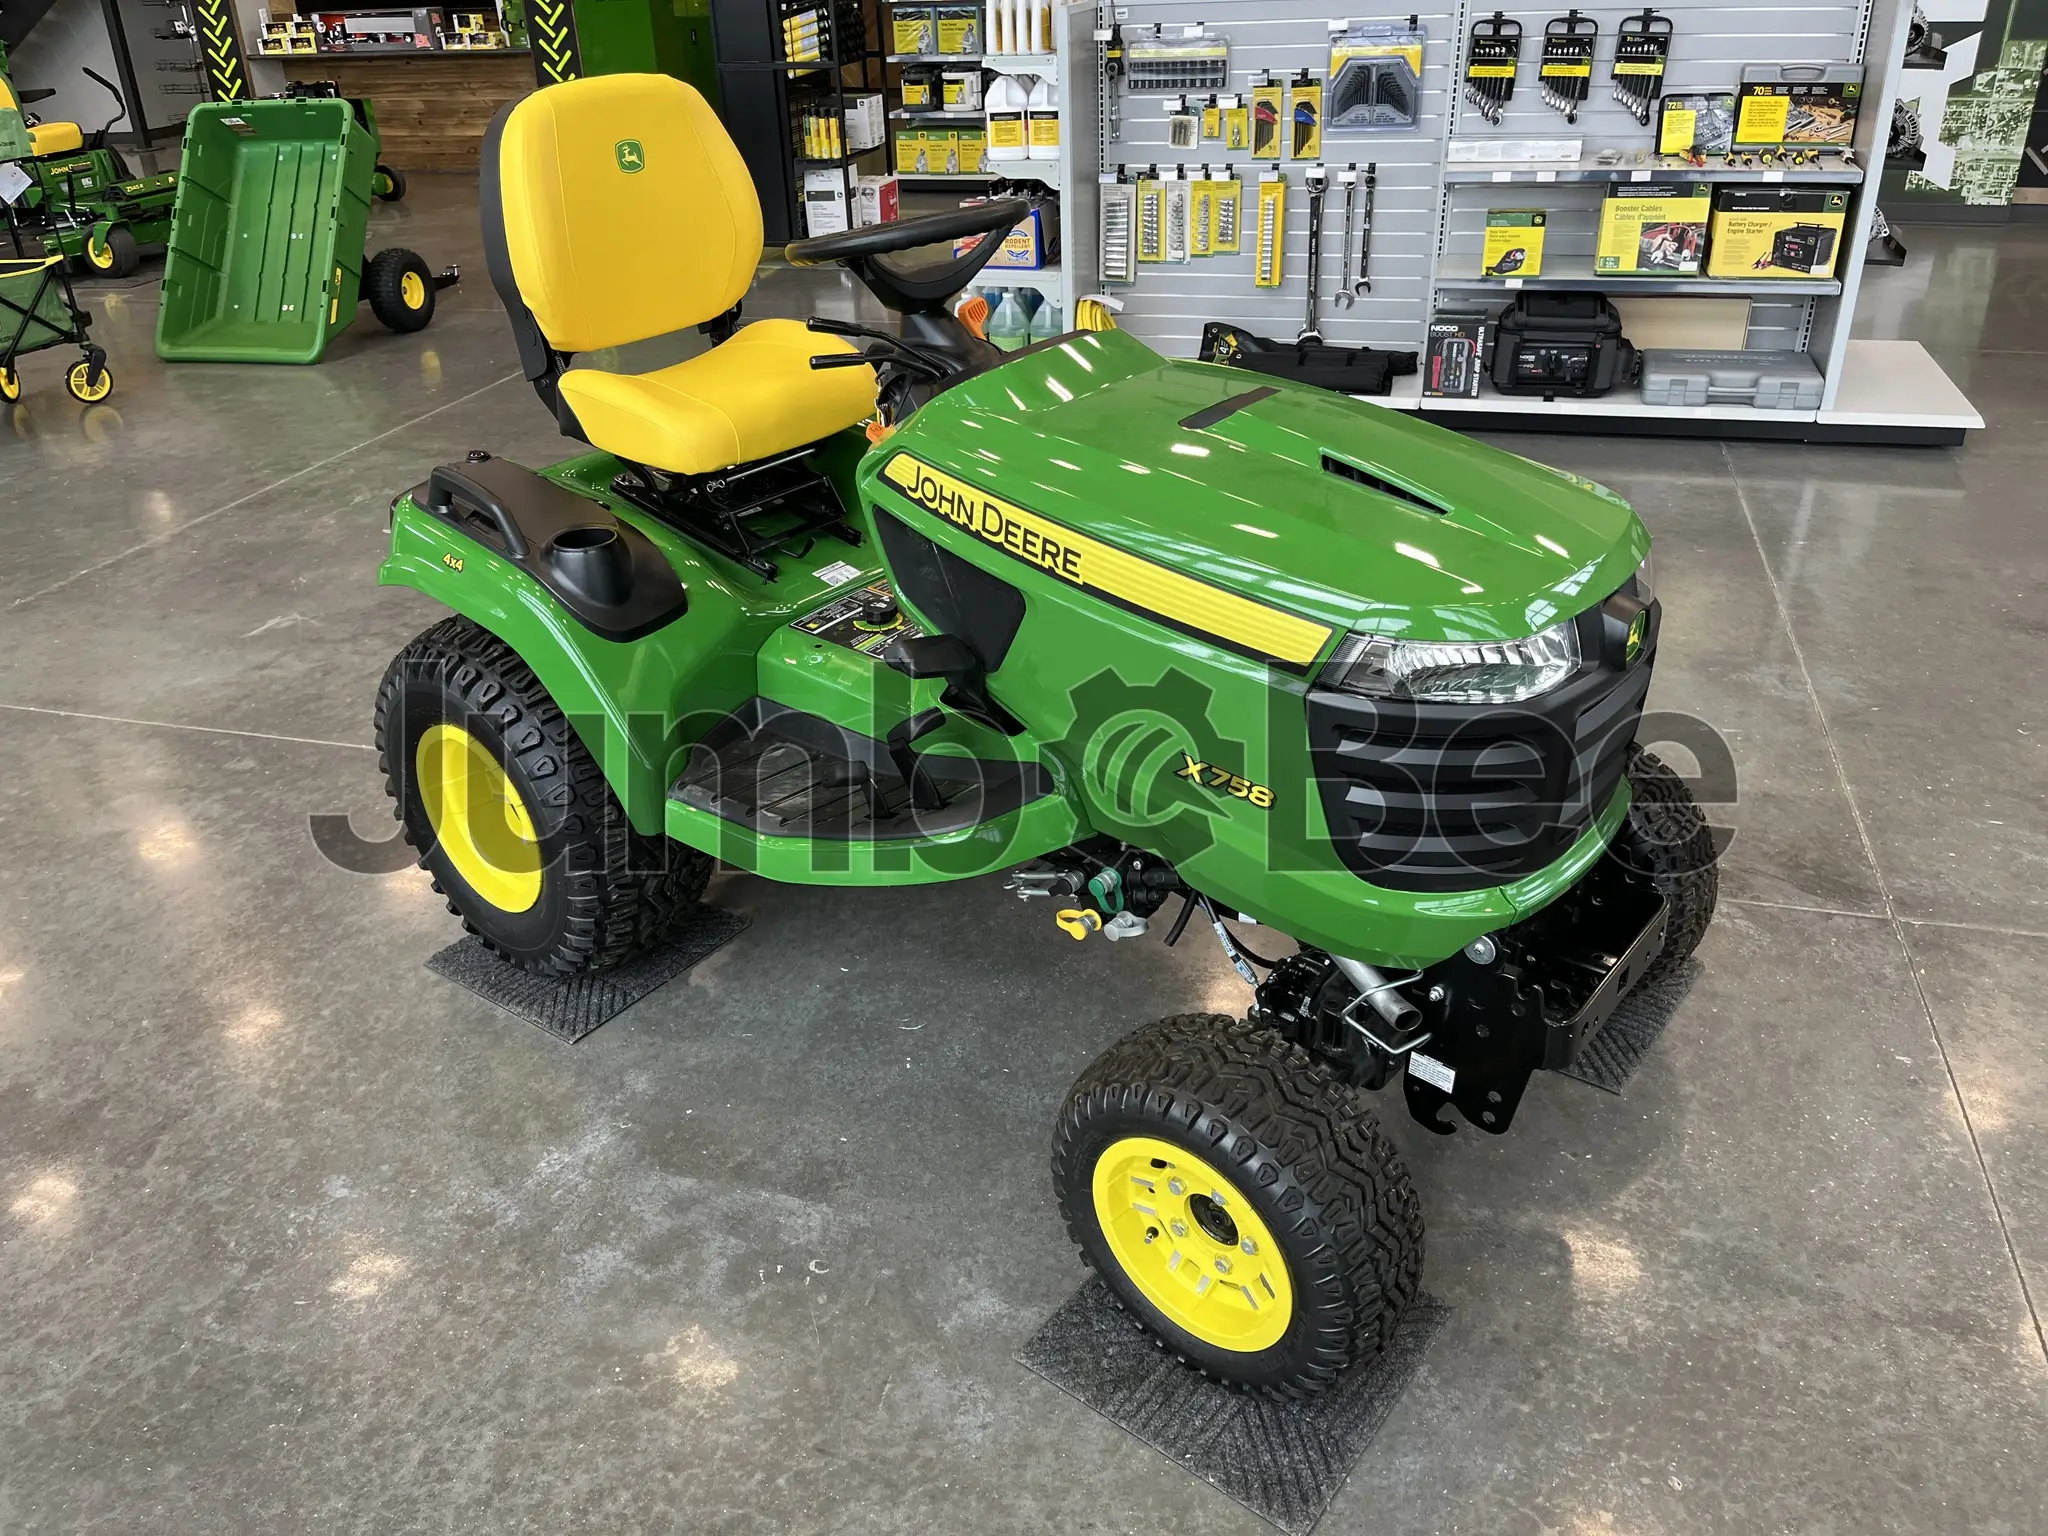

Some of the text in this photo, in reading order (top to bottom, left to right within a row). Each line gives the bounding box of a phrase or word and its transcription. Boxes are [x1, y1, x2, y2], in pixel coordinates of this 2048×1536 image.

[1753, 86, 1764, 95] 70
[1667, 102, 1677, 110] 72
[1471, 373, 1480, 398] STARTER
[906, 466, 1083, 580] JOHN DEERE
[443, 552, 464, 572] 4x4
[1172, 751, 1277, 811] X758
